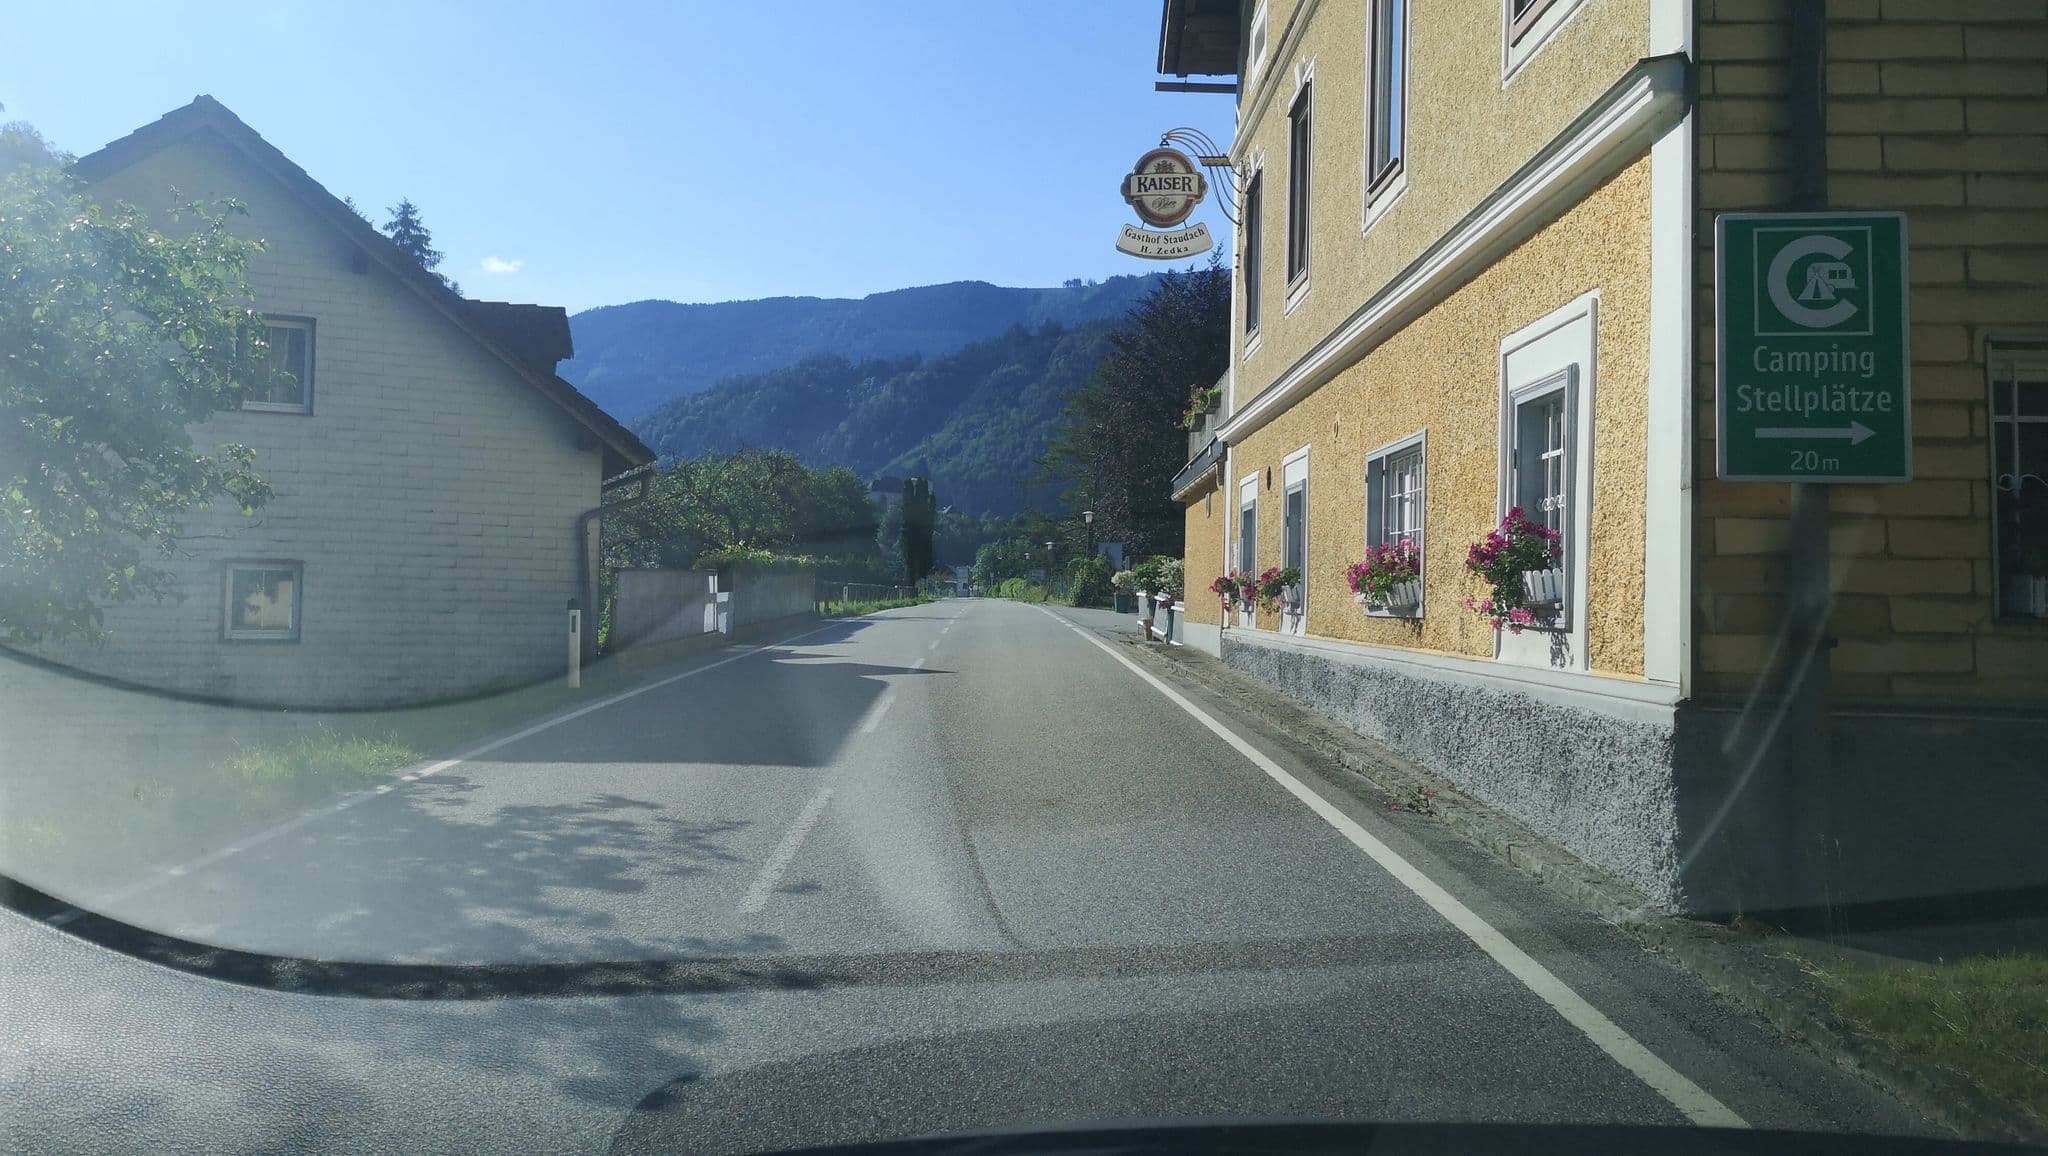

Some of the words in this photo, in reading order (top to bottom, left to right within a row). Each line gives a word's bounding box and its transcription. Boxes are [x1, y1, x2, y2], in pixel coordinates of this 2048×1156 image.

[1137, 176, 1192, 193] KAISER
[1125, 228, 1160, 244] Gasthof
[1163, 228, 1205, 244] Staudach
[1141, 246, 1152, 254] H.
[1156, 246, 1189, 255] Zedka
[1753, 343, 1875, 378] Camping
[1736, 384, 1892, 418] Stellplätze
